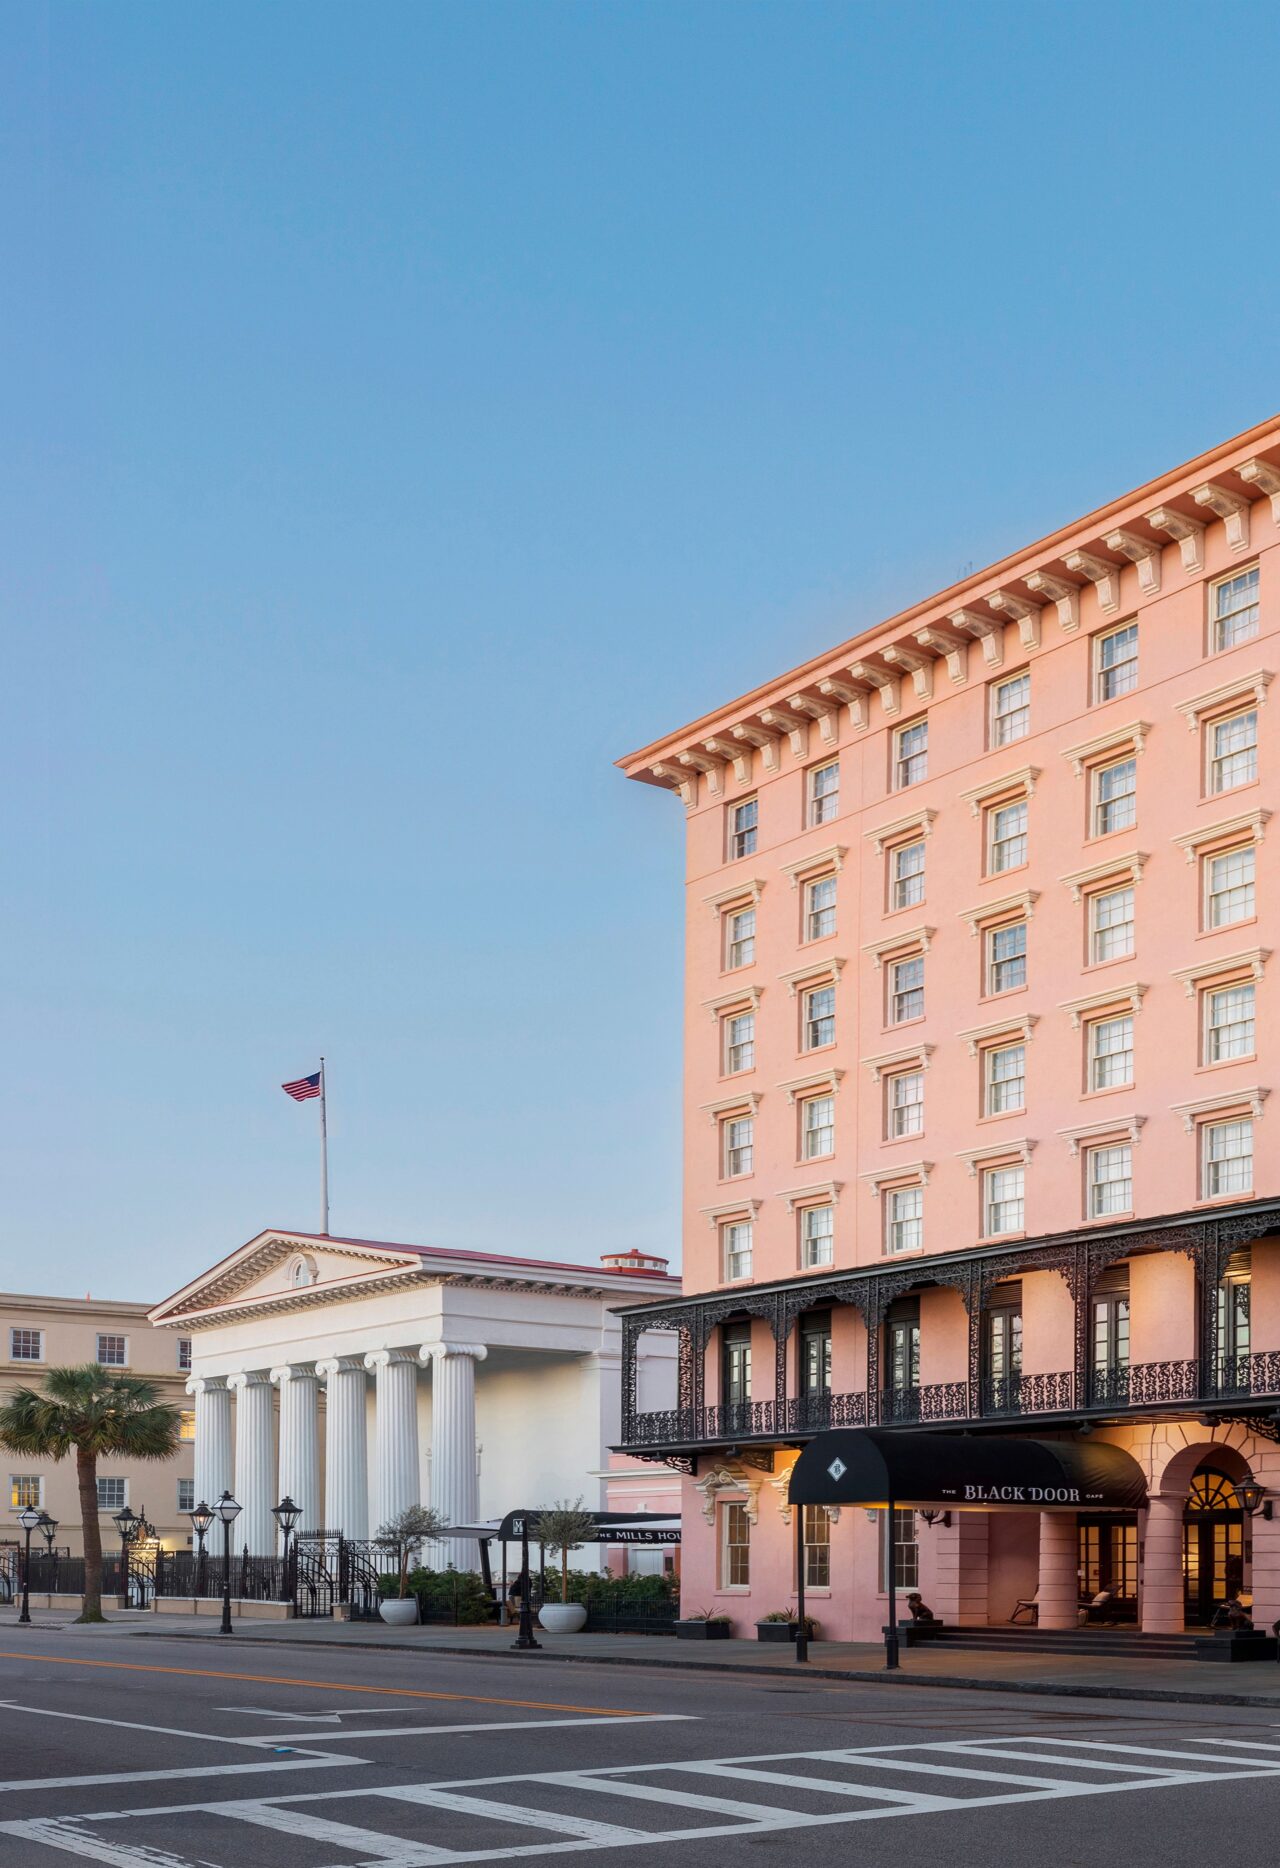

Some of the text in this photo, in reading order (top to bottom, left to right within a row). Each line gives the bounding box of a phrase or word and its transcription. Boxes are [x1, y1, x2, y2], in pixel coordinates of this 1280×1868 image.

[964, 1484, 1025, 1500] BLACK
[1027, 1487, 1081, 1502] DOOR
[616, 1531, 653, 1540] MILLS
